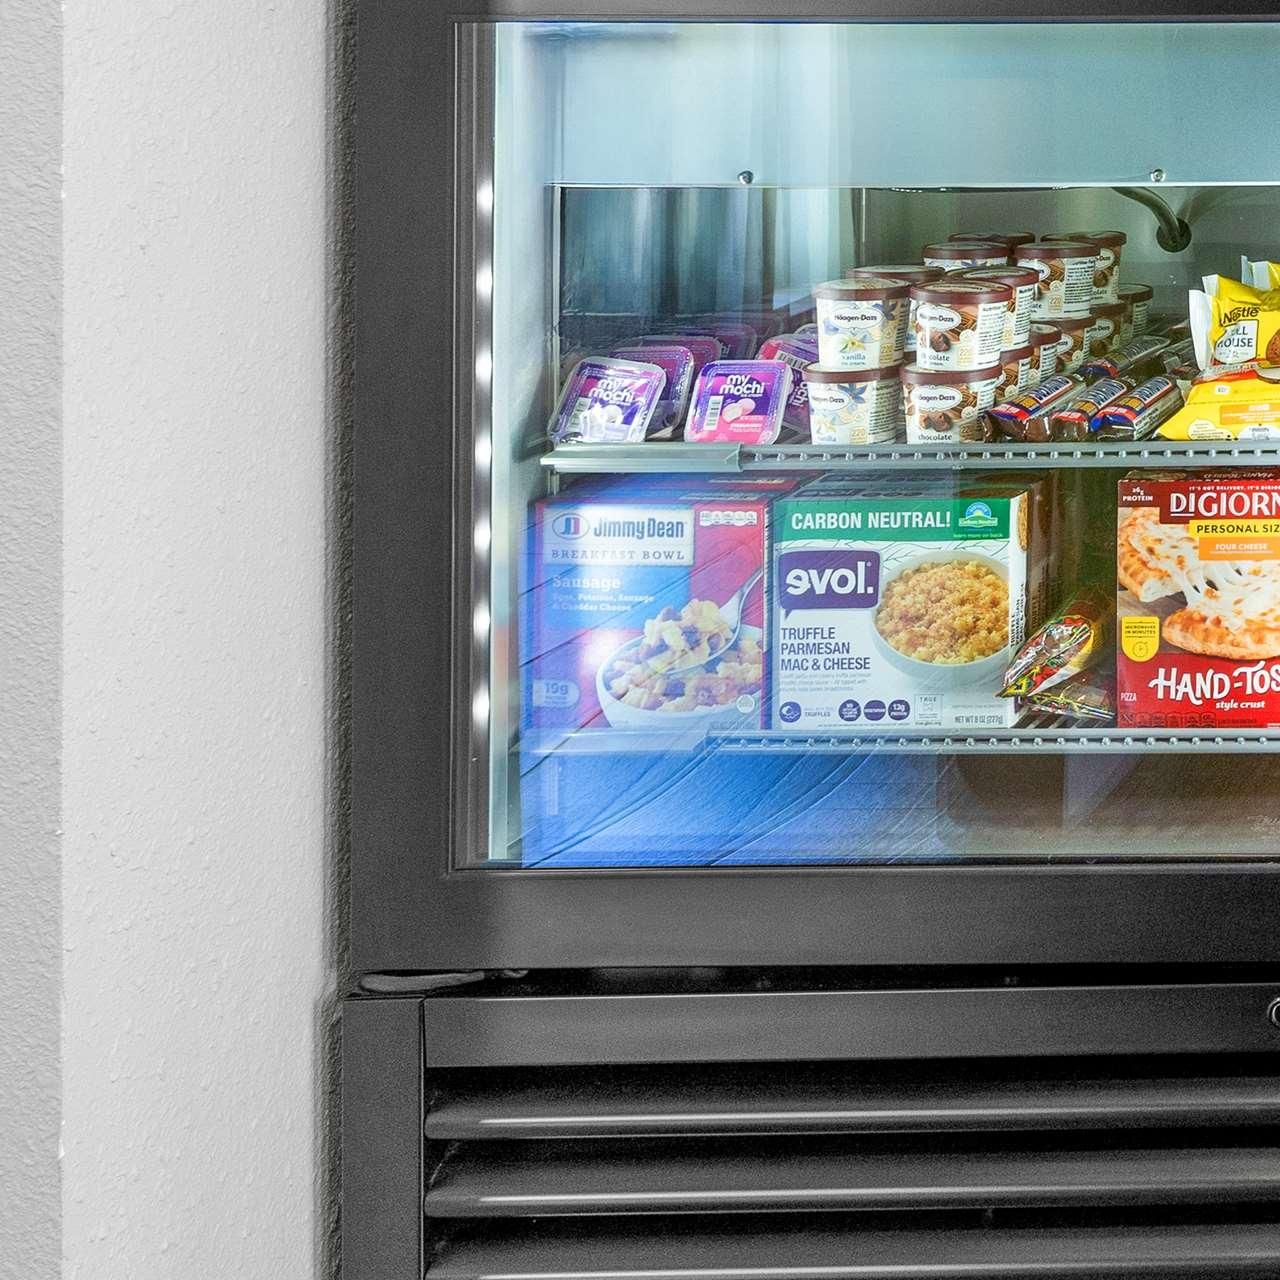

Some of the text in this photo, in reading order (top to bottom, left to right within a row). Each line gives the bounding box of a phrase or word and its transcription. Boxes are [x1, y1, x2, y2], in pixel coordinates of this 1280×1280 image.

[791, 511, 950, 530] CARBON NEUTRAL!
[1196, 524, 1259, 535] PERSONAL
[552, 576, 622, 592] Sausage
[784, 560, 875, 595] evol.
[781, 627, 836, 640] TRUFFLE
[781, 642, 851, 655] PARMESAN
[1120, 692, 1137, 703] PIZZA
